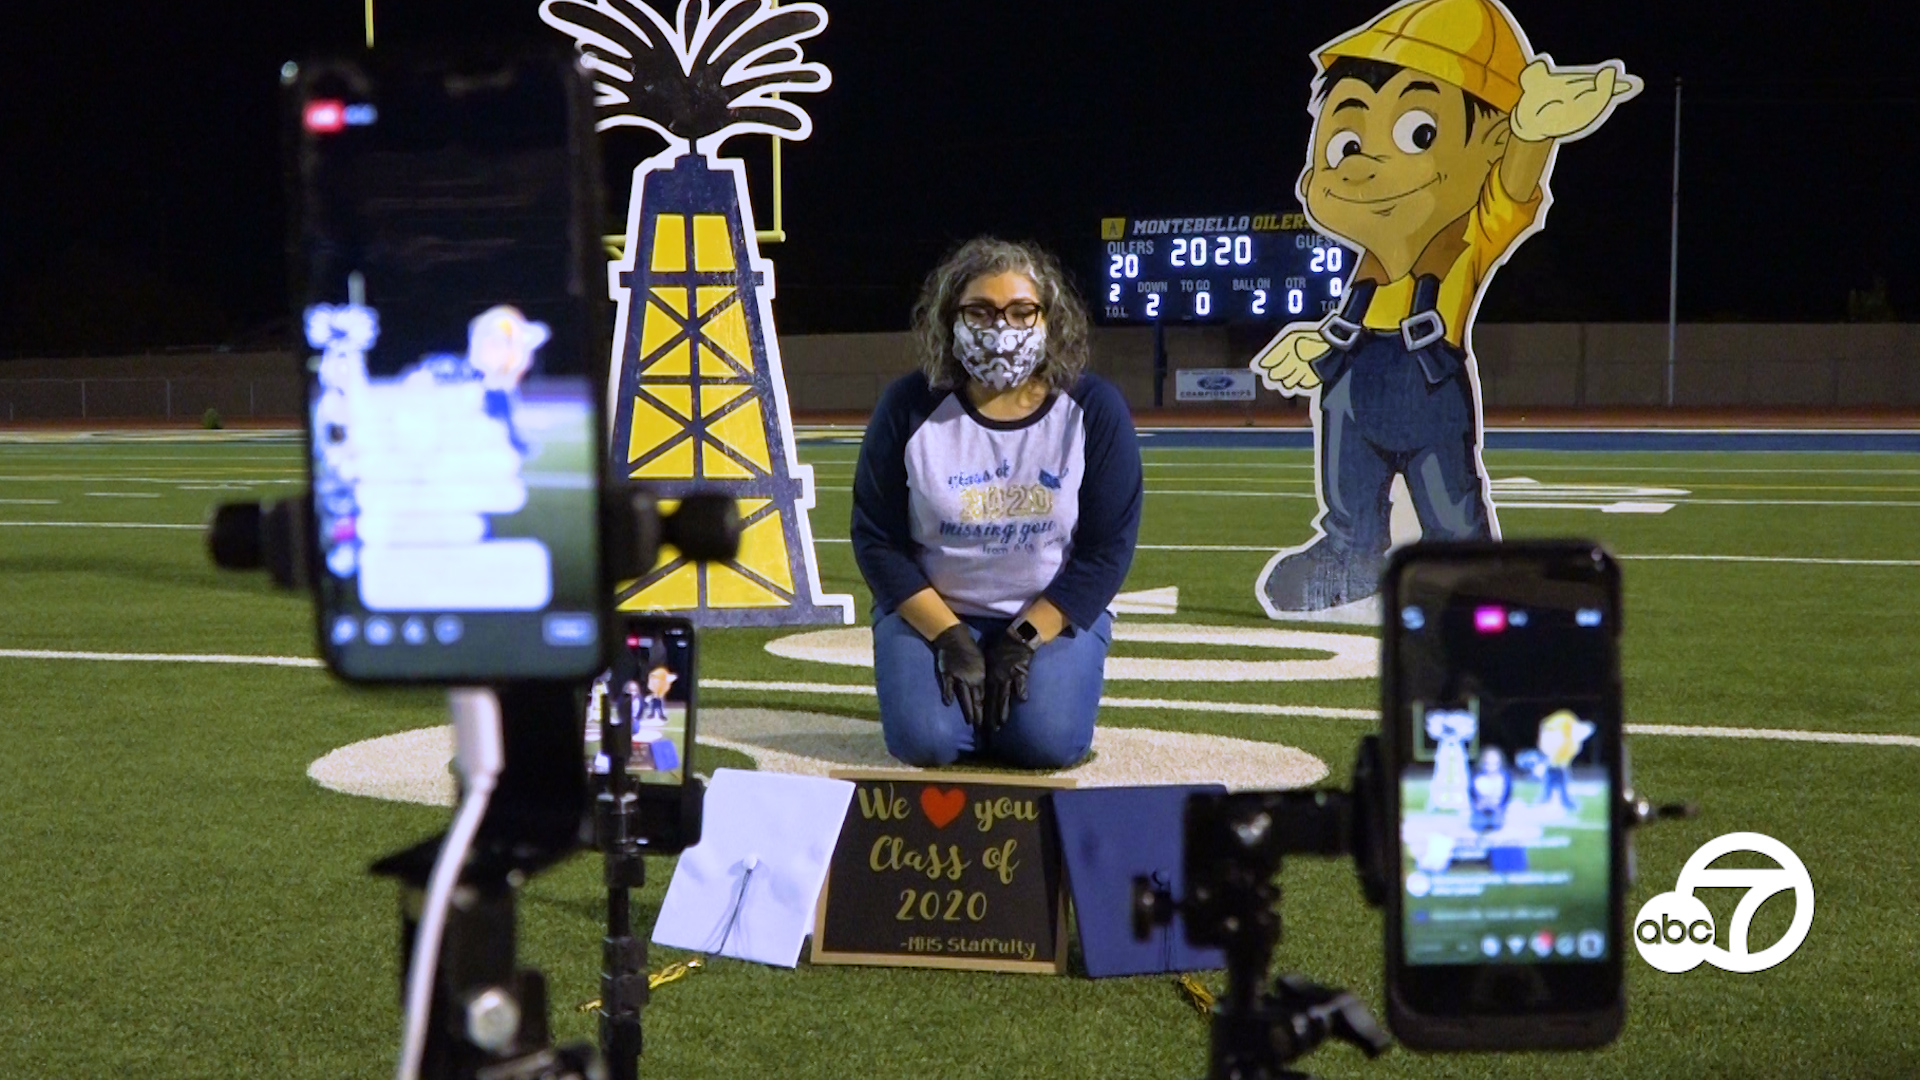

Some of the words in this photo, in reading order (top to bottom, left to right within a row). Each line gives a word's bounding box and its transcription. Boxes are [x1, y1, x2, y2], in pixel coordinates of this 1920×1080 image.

[1132, 215, 1250, 235] MONTEBELLO
[1107, 241, 1154, 254] OILERS
[1310, 246, 1342, 272] 20
[1109, 254, 1139, 278] 20
[1109, 283, 1120, 302] 2
[1137, 281, 1168, 292] DOWN
[1181, 280, 1193, 291] TO
[1196, 279, 1210, 291] GO
[1232, 279, 1255, 291] BALL
[1257, 277, 1271, 289] ON
[1330, 277, 1342, 297] 0
[1146, 293, 1160, 317] 2
[1195, 291, 1211, 316] 0
[1252, 289, 1266, 315] 2
[1288, 289, 1303, 314] 0
[960, 484, 1053, 522] 2020
[939, 521, 1017, 544] missing
[1019, 520, 1056, 543] you
[858, 782, 911, 821] We
[974, 797, 1039, 832] you
[870, 835, 972, 880] Class
[982, 838, 1020, 885] of
[895, 889, 987, 921] 2020
